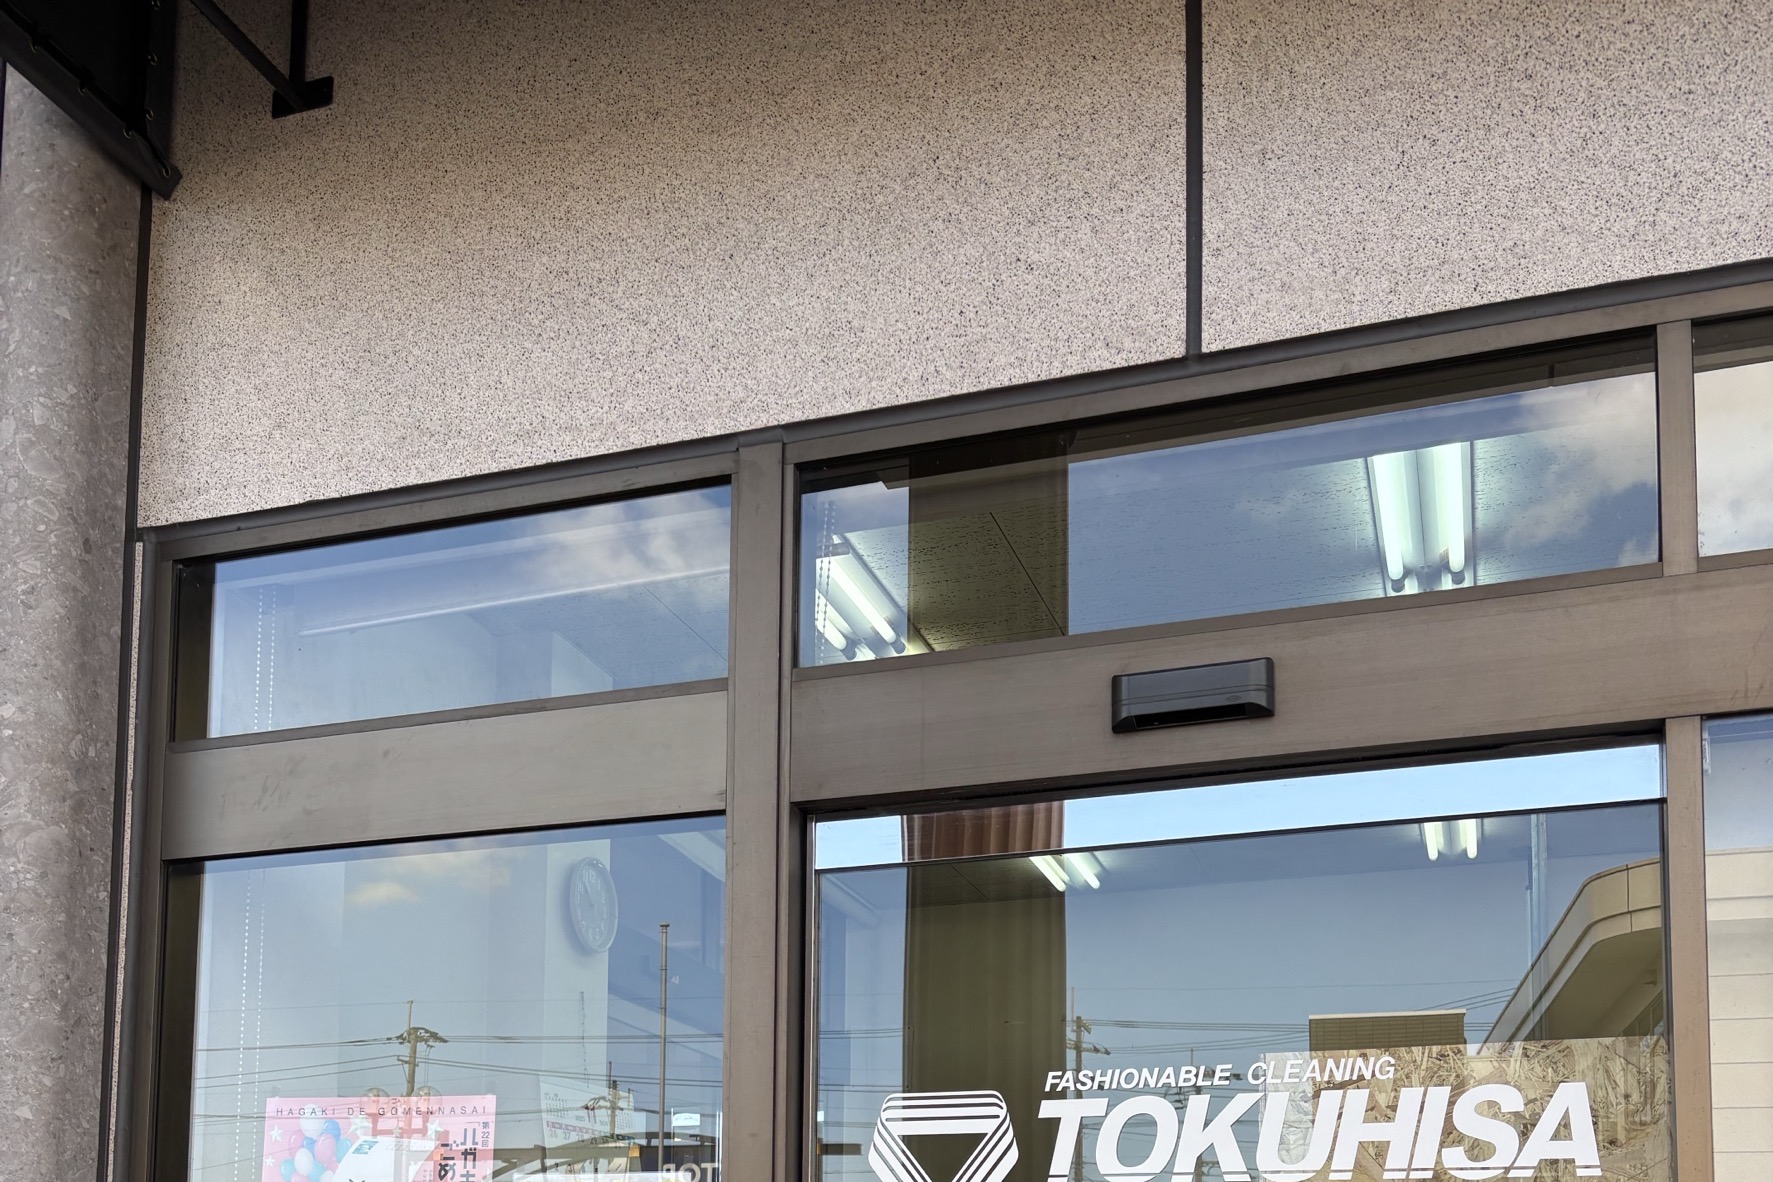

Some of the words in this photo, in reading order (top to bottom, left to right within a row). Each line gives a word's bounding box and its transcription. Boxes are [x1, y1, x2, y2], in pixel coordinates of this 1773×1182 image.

[1044, 1063, 1231, 1091] FASHIONABLE
[1247, 1056, 1396, 1085] CLEANING
[276, 1107, 337, 1117] HAGAKI
[347, 1107, 366, 1116] DE
[378, 1105, 487, 1117] GOMENNASAI
[481, 1121, 491, 1148] 第22回
